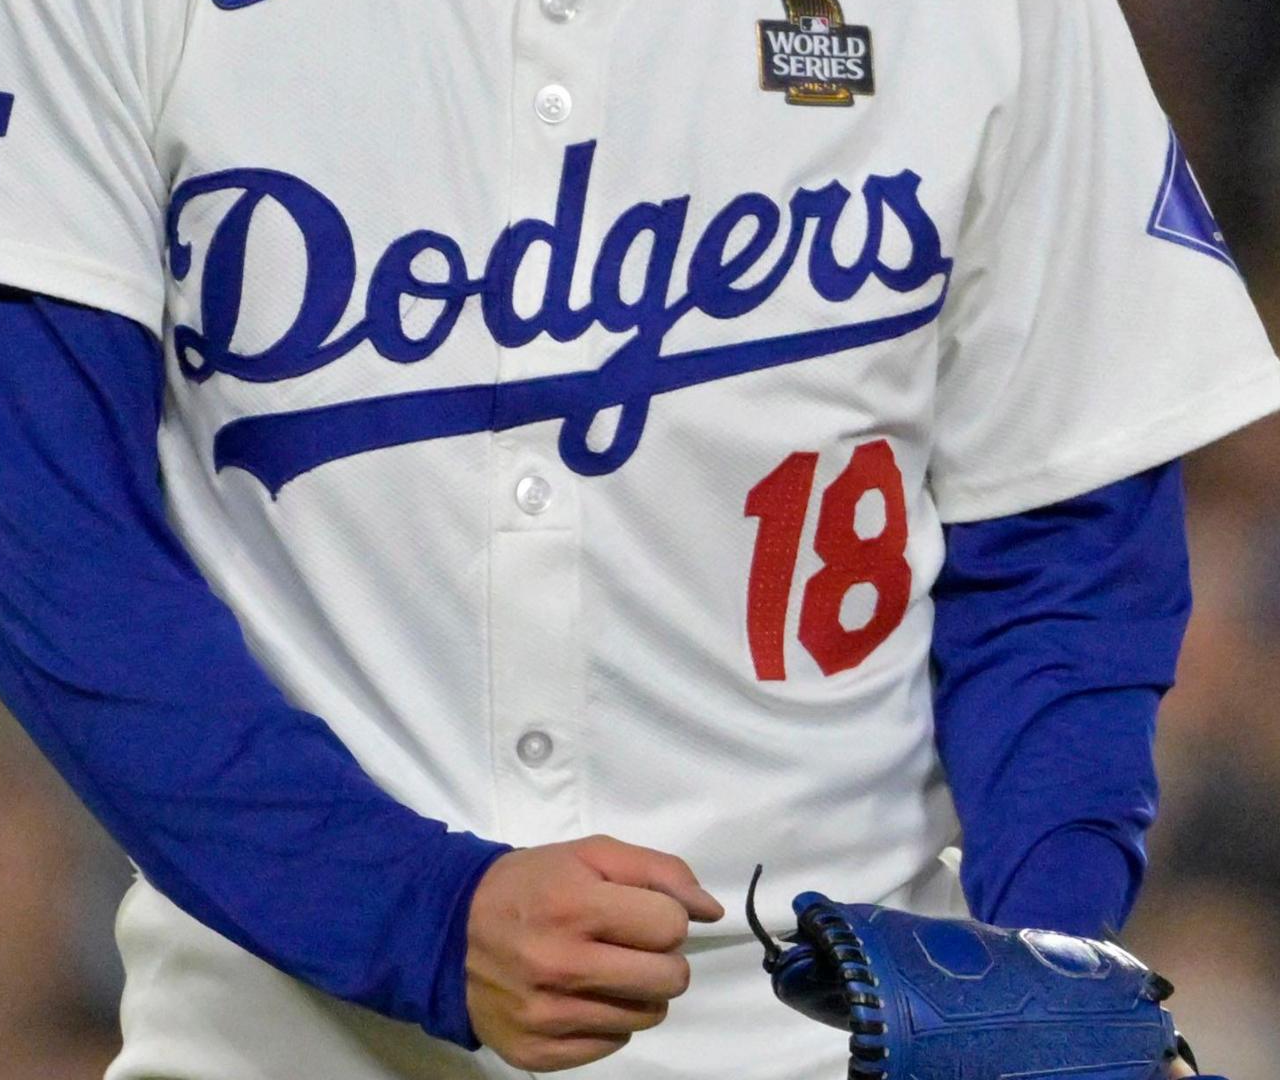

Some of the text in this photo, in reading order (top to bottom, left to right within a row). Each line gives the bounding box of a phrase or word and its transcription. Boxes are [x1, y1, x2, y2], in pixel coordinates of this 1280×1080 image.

[766, 30, 866, 58] WORLD
[772, 53, 865, 81] SERIES
[167, 138, 955, 476] Dodgers
[743, 439, 912, 681] 18
